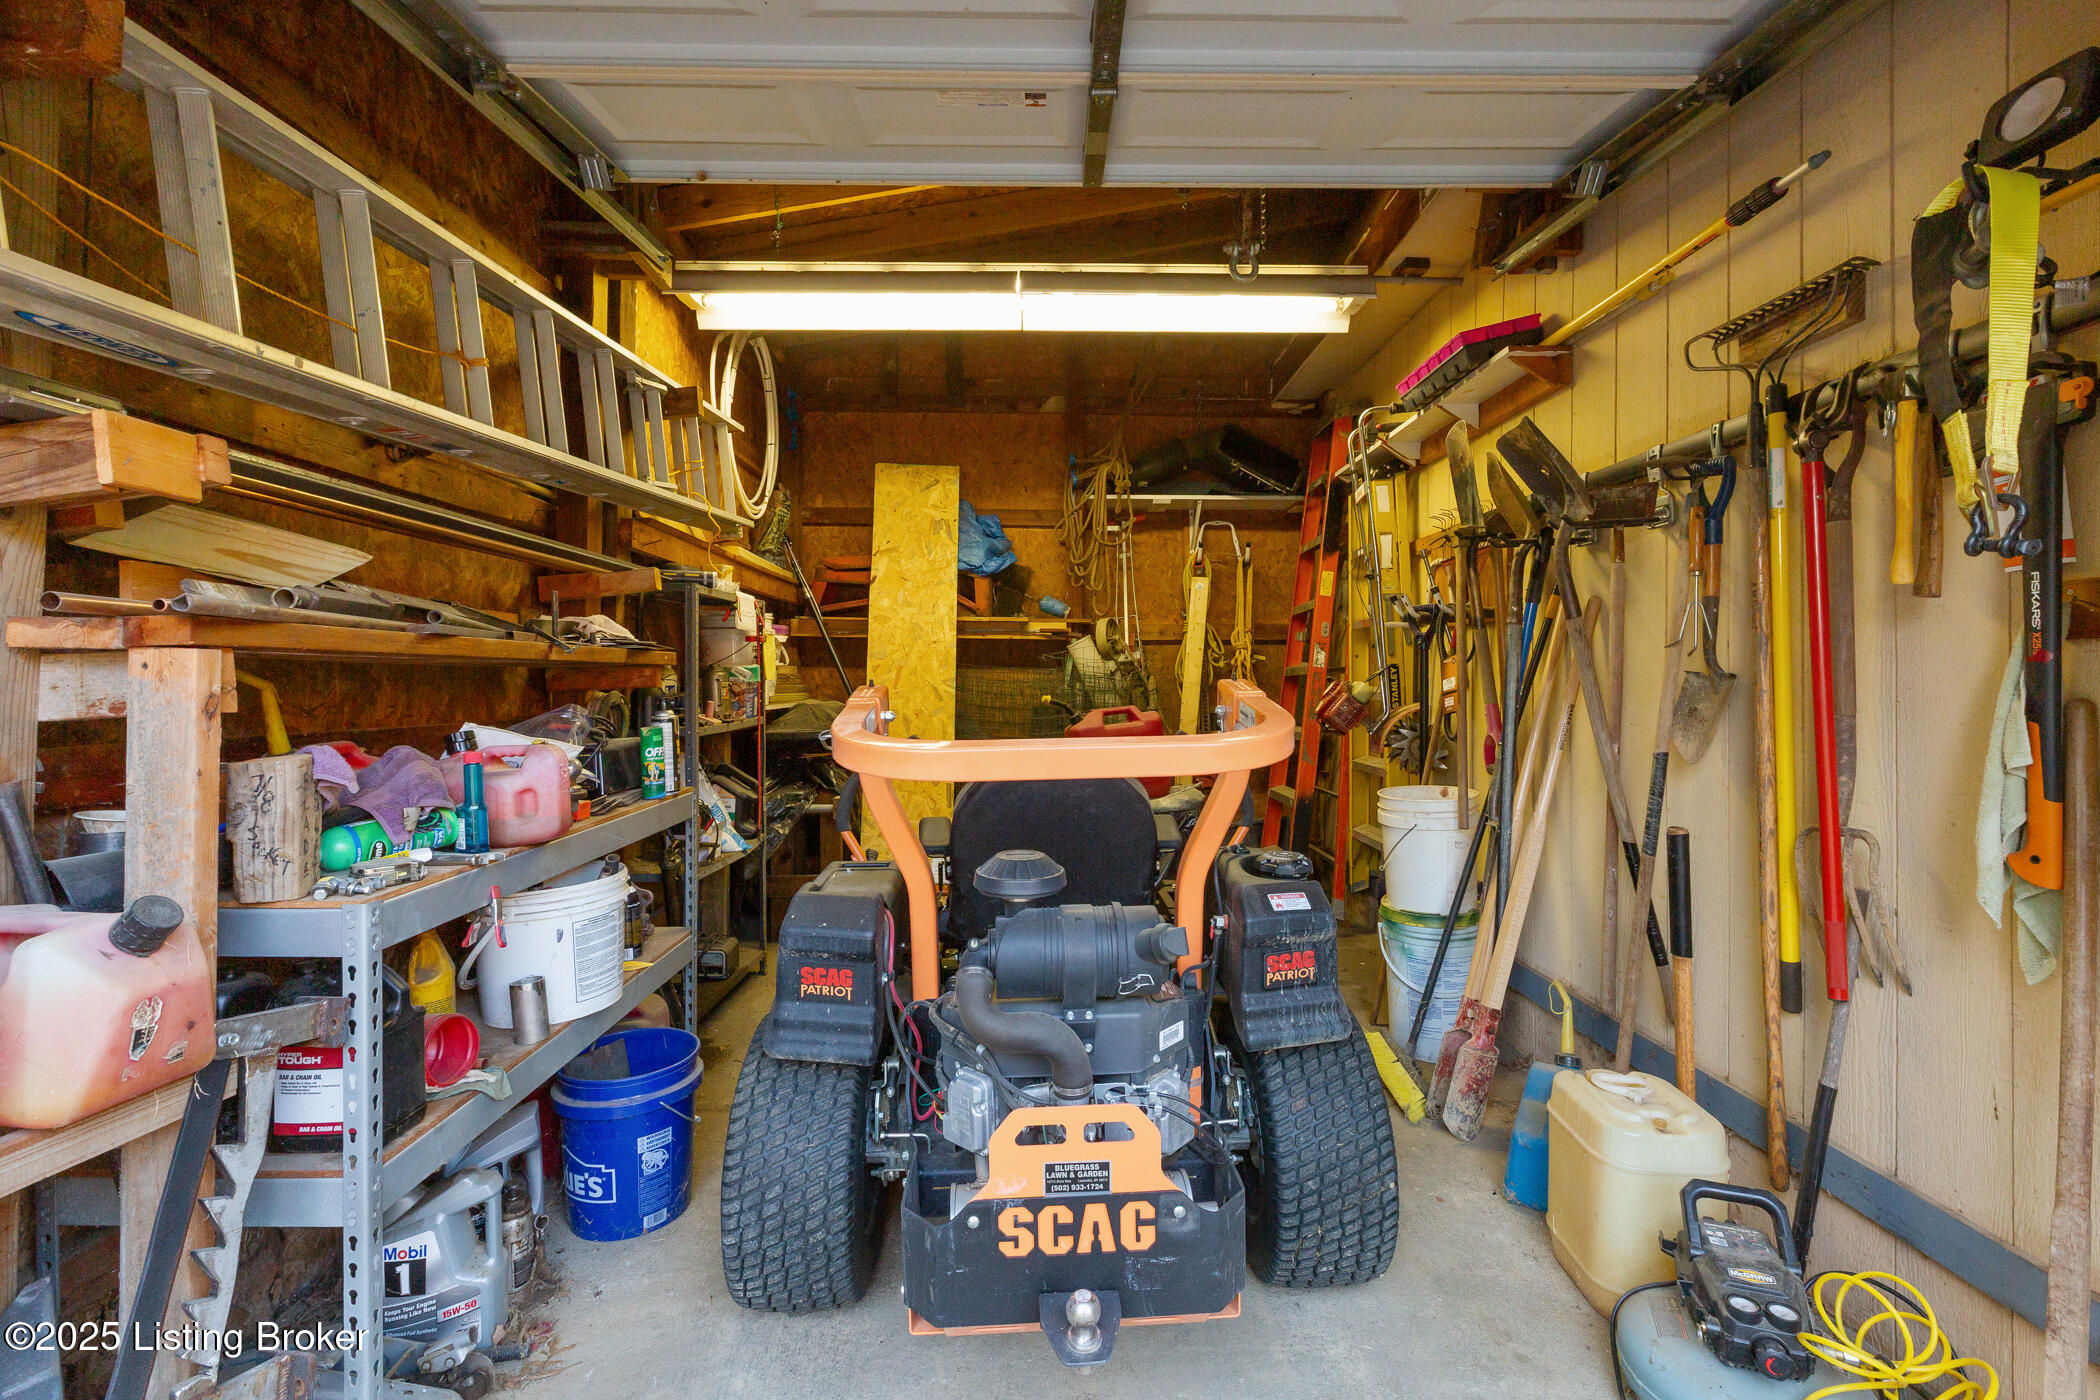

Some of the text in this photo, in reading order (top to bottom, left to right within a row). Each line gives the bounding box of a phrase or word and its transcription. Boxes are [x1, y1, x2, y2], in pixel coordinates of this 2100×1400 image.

[2031, 571, 2041, 629] FISKARS
[1390, 668, 1400, 709] STANLEY
[1266, 950, 1316, 973] SCAG
[800, 966, 853, 987] SCAG
[1266, 967, 1316, 987] PATRIOT
[800, 984, 853, 1001] PATRIOT
[278, 1056, 322, 1065] TOUGH
[1077, 1170, 1109, 1178] GARDEN
[1051, 1183, 1104, 1192] (502) 933-1724
[997, 1200, 1157, 1259] SCAG
[384, 1244, 427, 1261] Mobil
[395, 1262, 411, 1296] 1
[384, 1305, 437, 1323] Running Like New
[402, 1305, 416, 1314] Your
[416, 1299, 437, 1311] Engine
[441, 1299, 477, 1319] 15W-50
